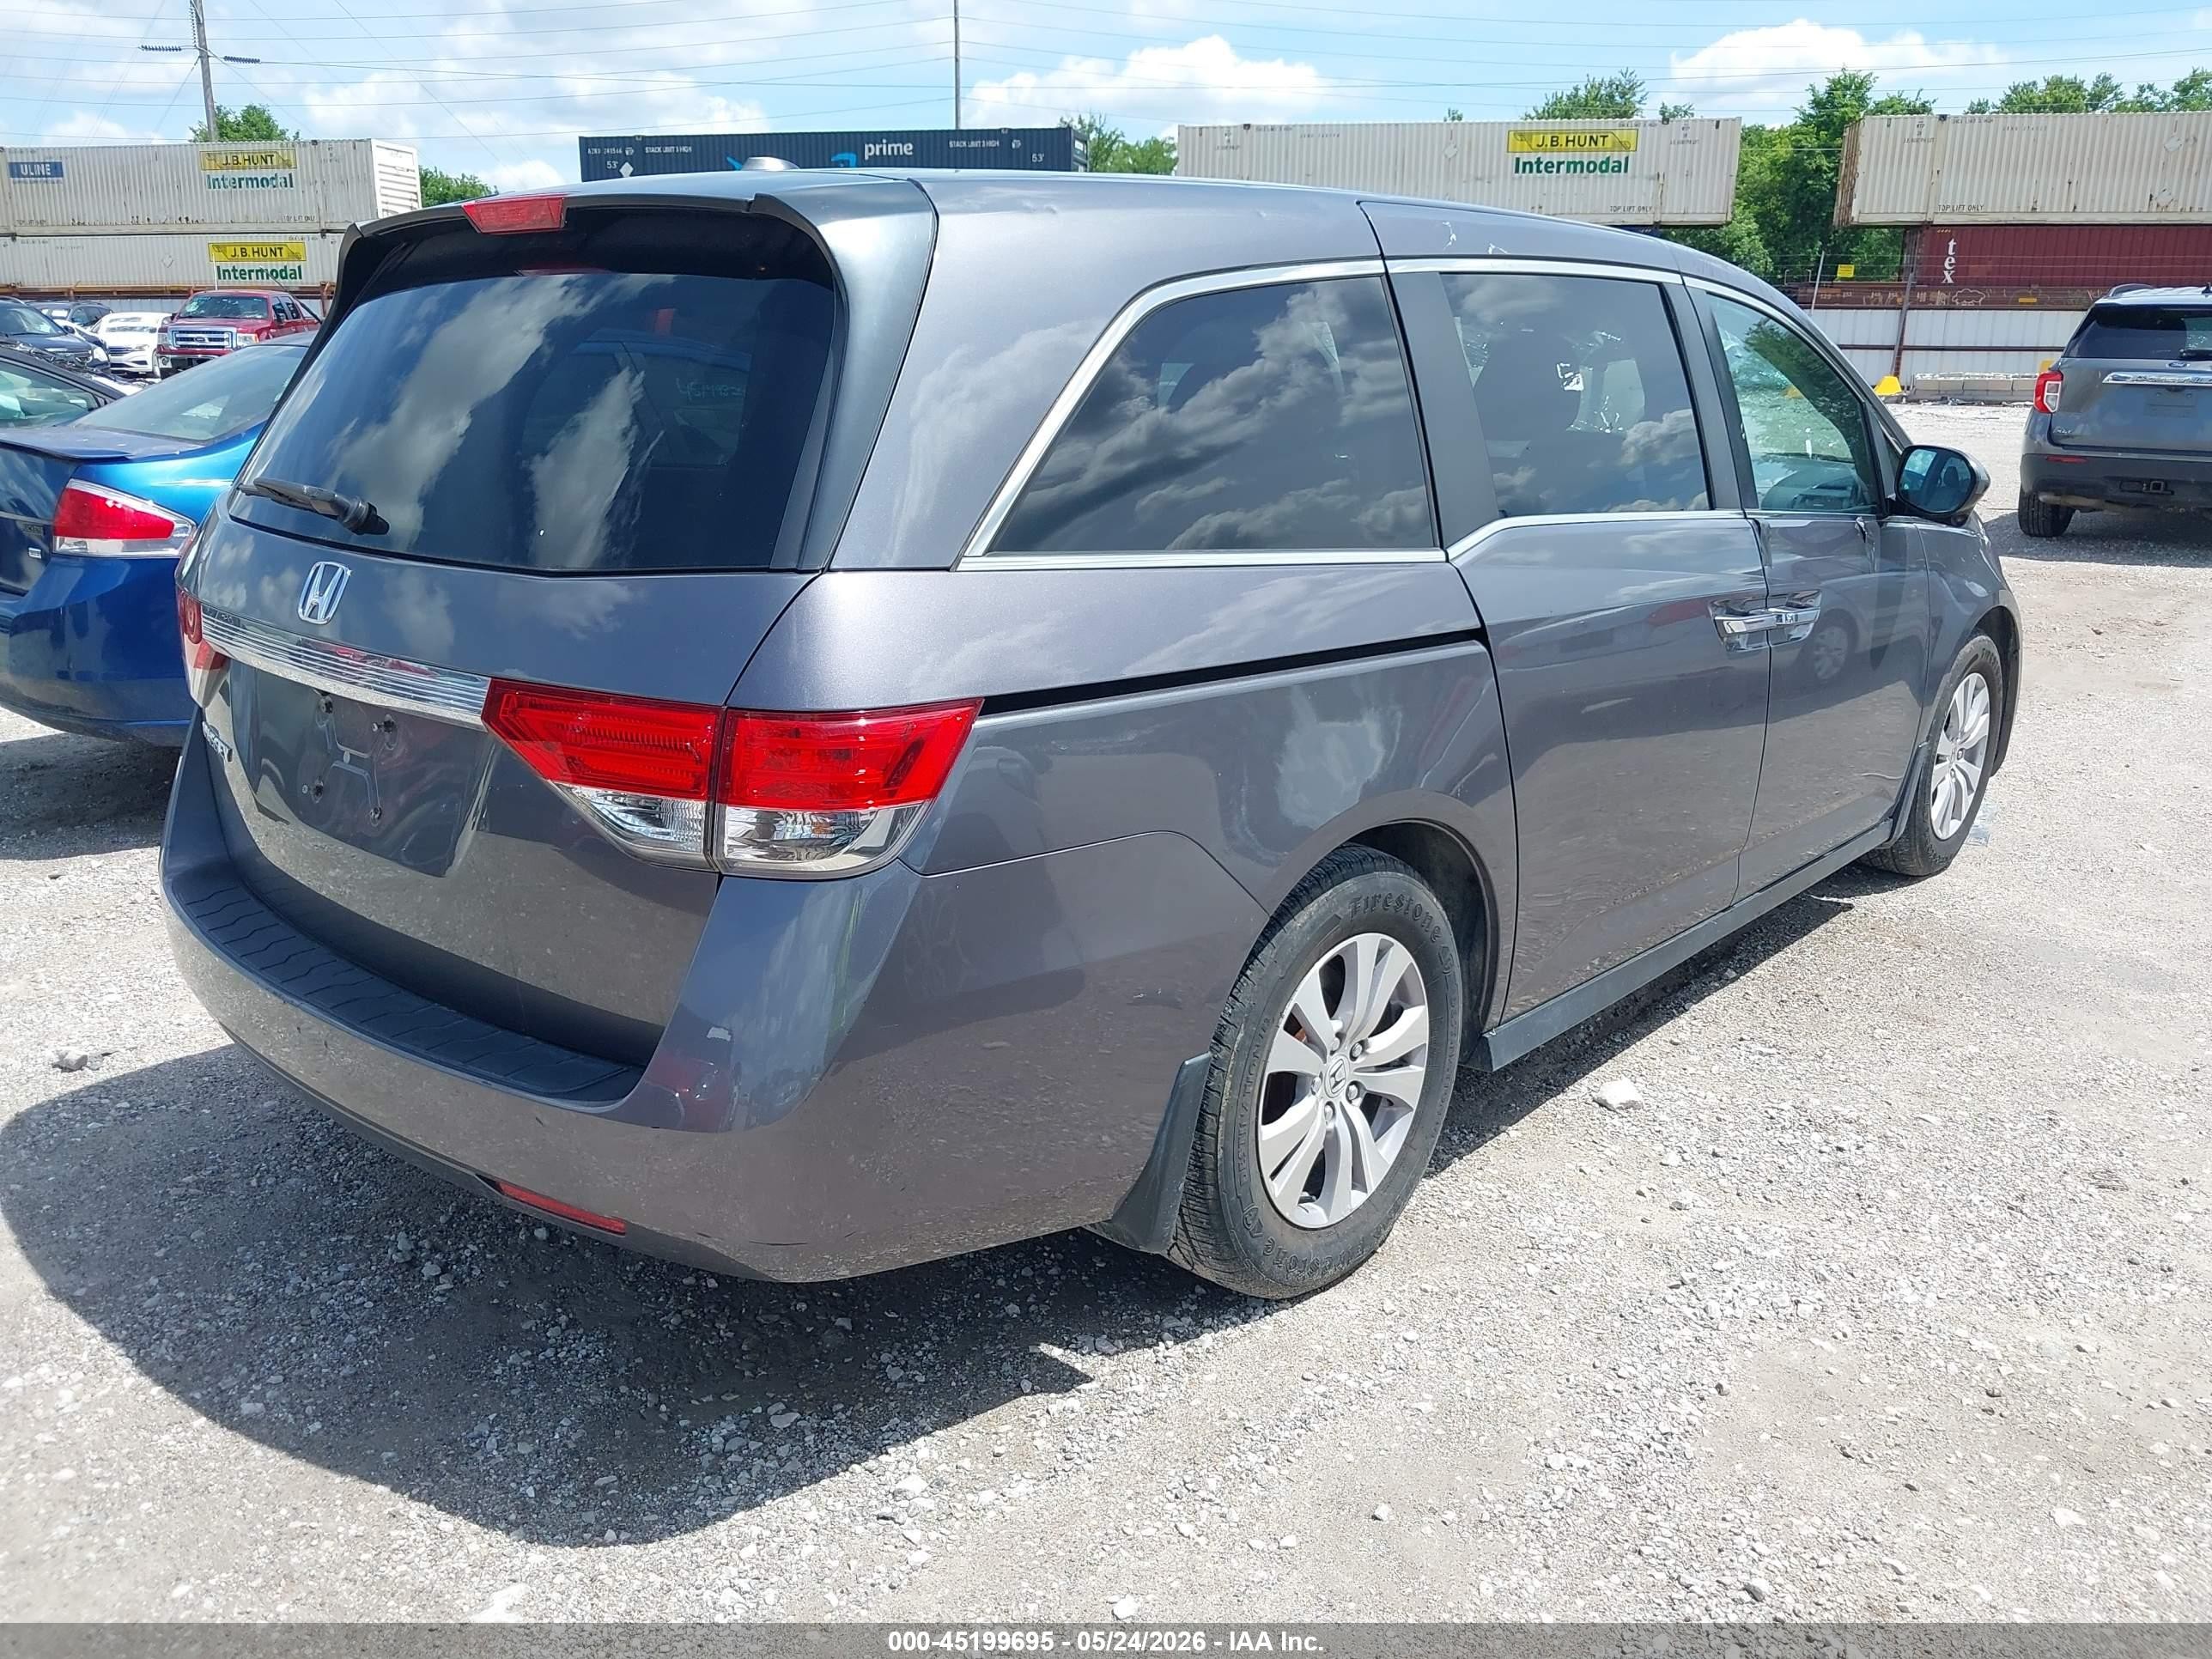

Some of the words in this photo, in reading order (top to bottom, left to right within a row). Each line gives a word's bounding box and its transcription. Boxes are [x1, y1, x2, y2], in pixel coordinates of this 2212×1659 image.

[864, 139, 914, 161] prime
[20, 163, 52, 176] ULINE
[1514, 156, 1630, 174] Intermodal
[206, 173, 295, 190] Intermodal
[216, 265, 302, 281] Intermodal
[1347, 892, 1443, 943] Firestone
